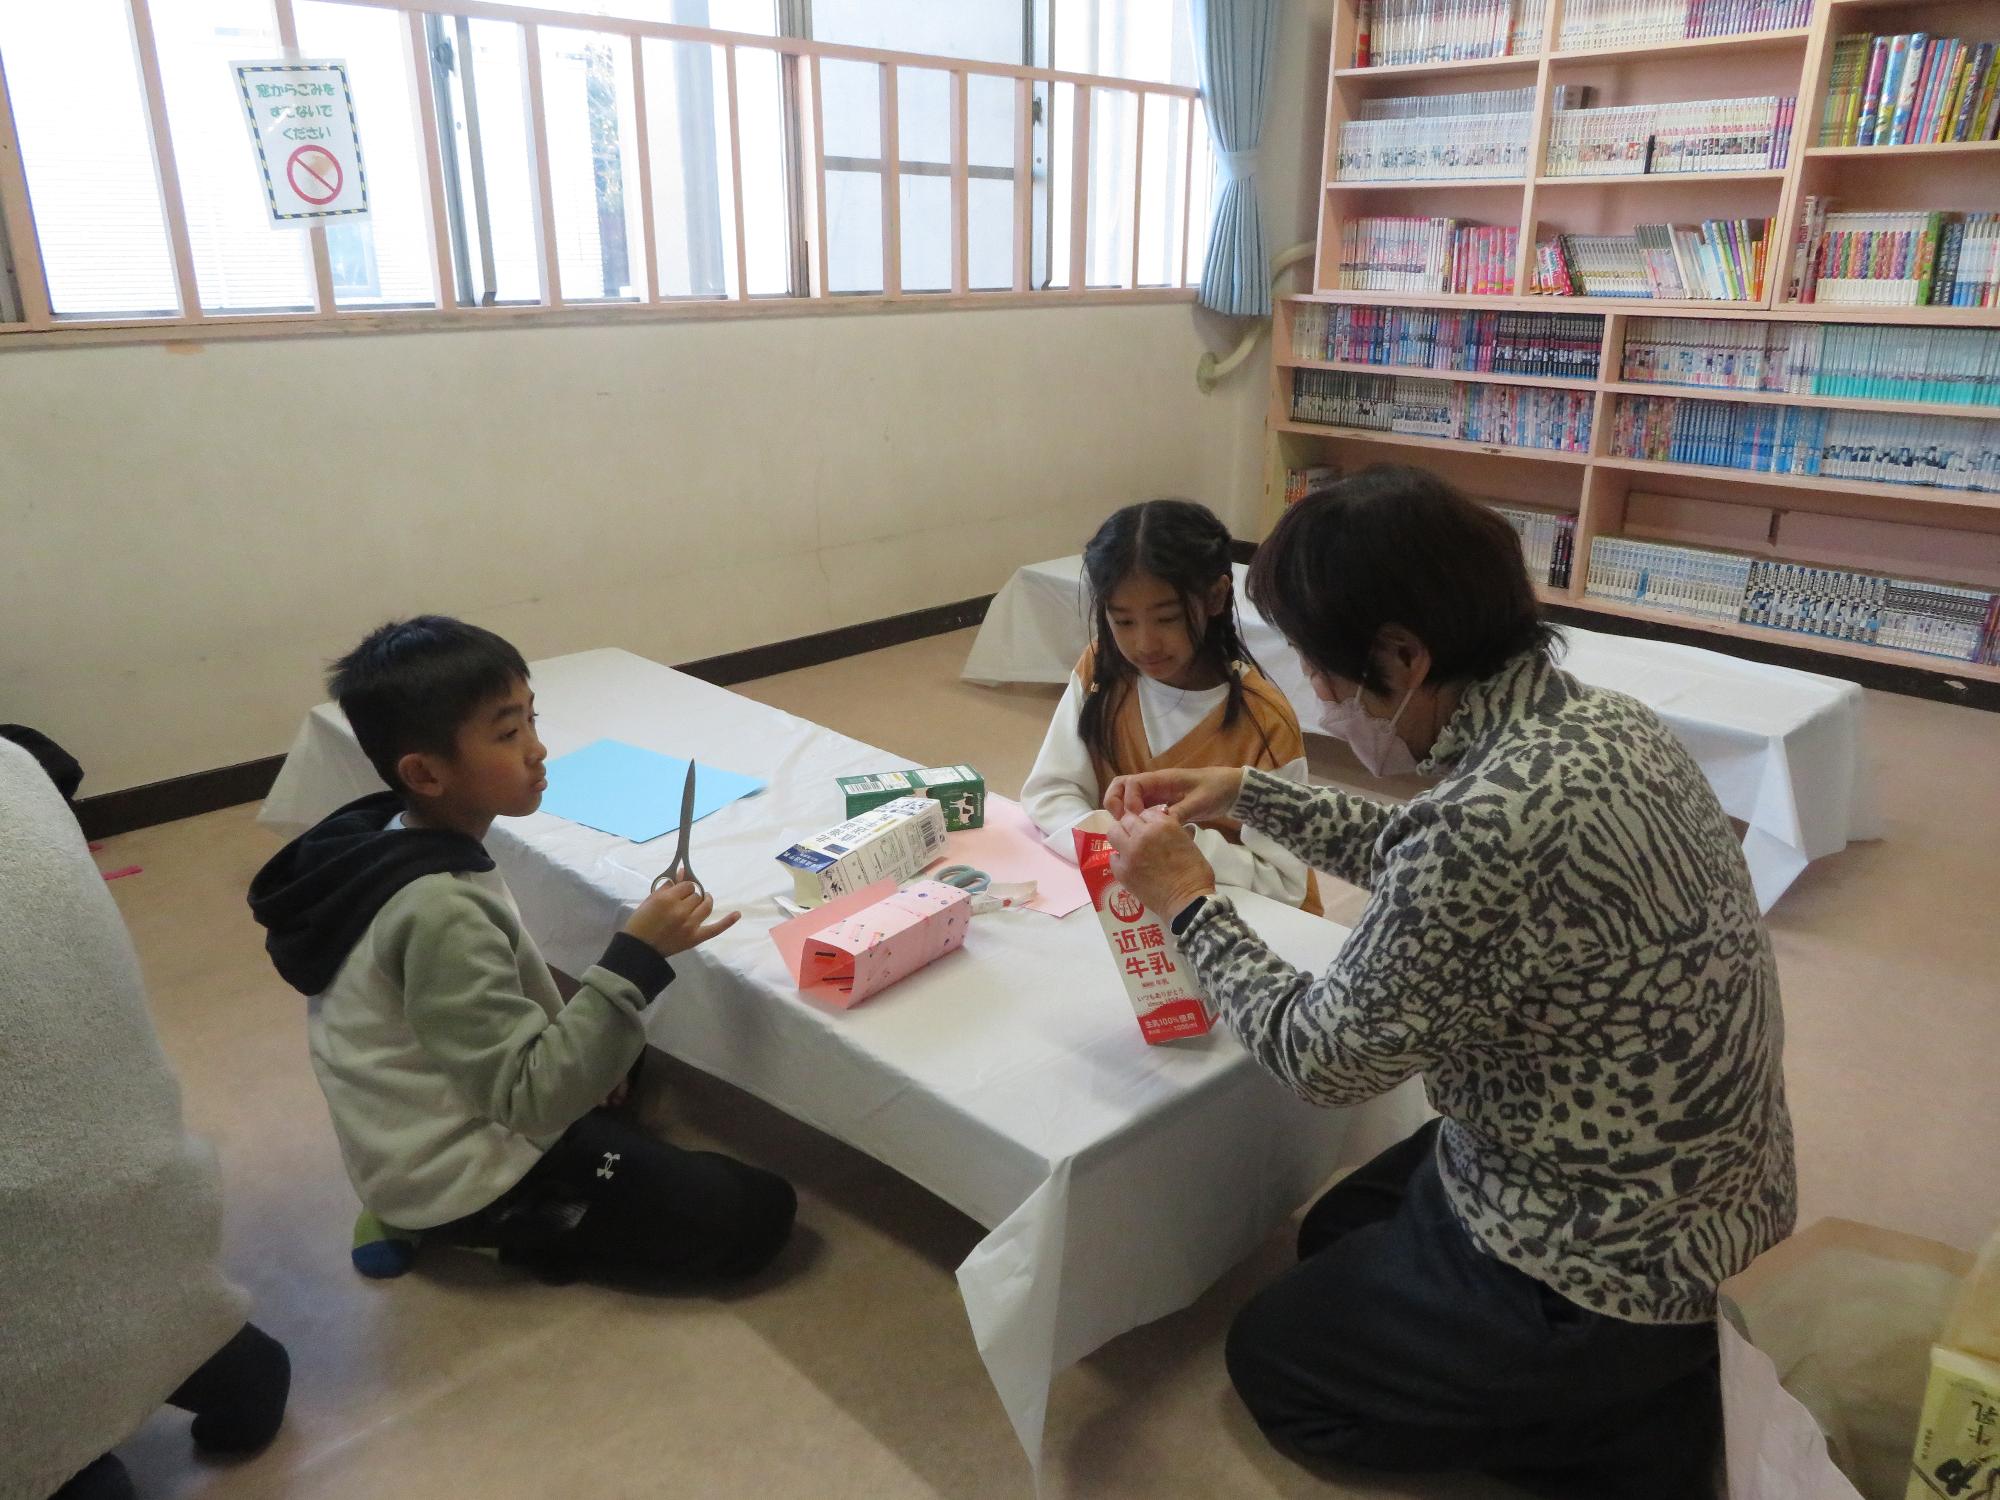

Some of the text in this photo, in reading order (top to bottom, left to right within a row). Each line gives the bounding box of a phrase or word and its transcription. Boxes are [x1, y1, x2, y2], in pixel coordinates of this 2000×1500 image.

[283, 127, 331, 141] ください
[1112, 923, 1166, 954] 近藤
[1125, 951, 1176, 978] 牛乳
